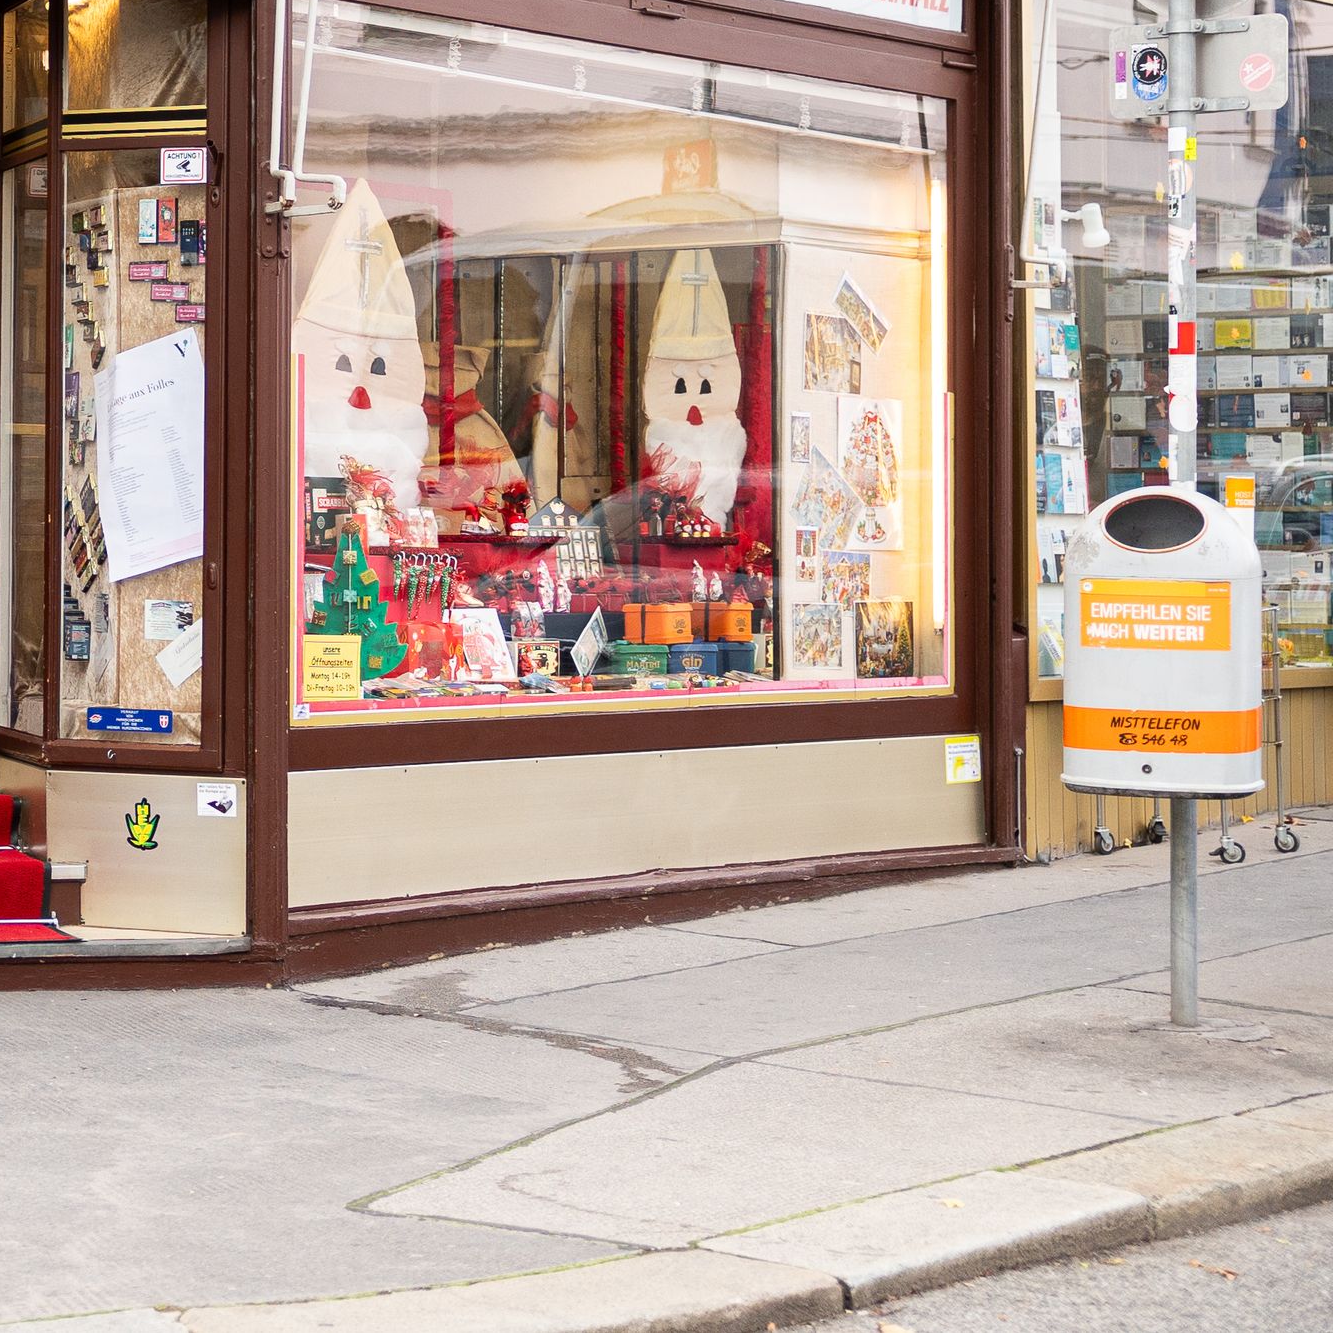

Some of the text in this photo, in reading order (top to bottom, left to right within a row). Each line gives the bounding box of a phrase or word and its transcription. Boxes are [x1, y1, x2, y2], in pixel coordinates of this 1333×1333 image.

[129, 388, 145, 400] aux
[147, 379, 175, 394] Folles
[1090, 602, 1212, 621] EMPFEHLEN SIE
[1090, 623, 1205, 641] MICH WEITER!
[1110, 716, 1200, 730] MISTTELEFON
[1142, 733, 1188, 746] 546 48
